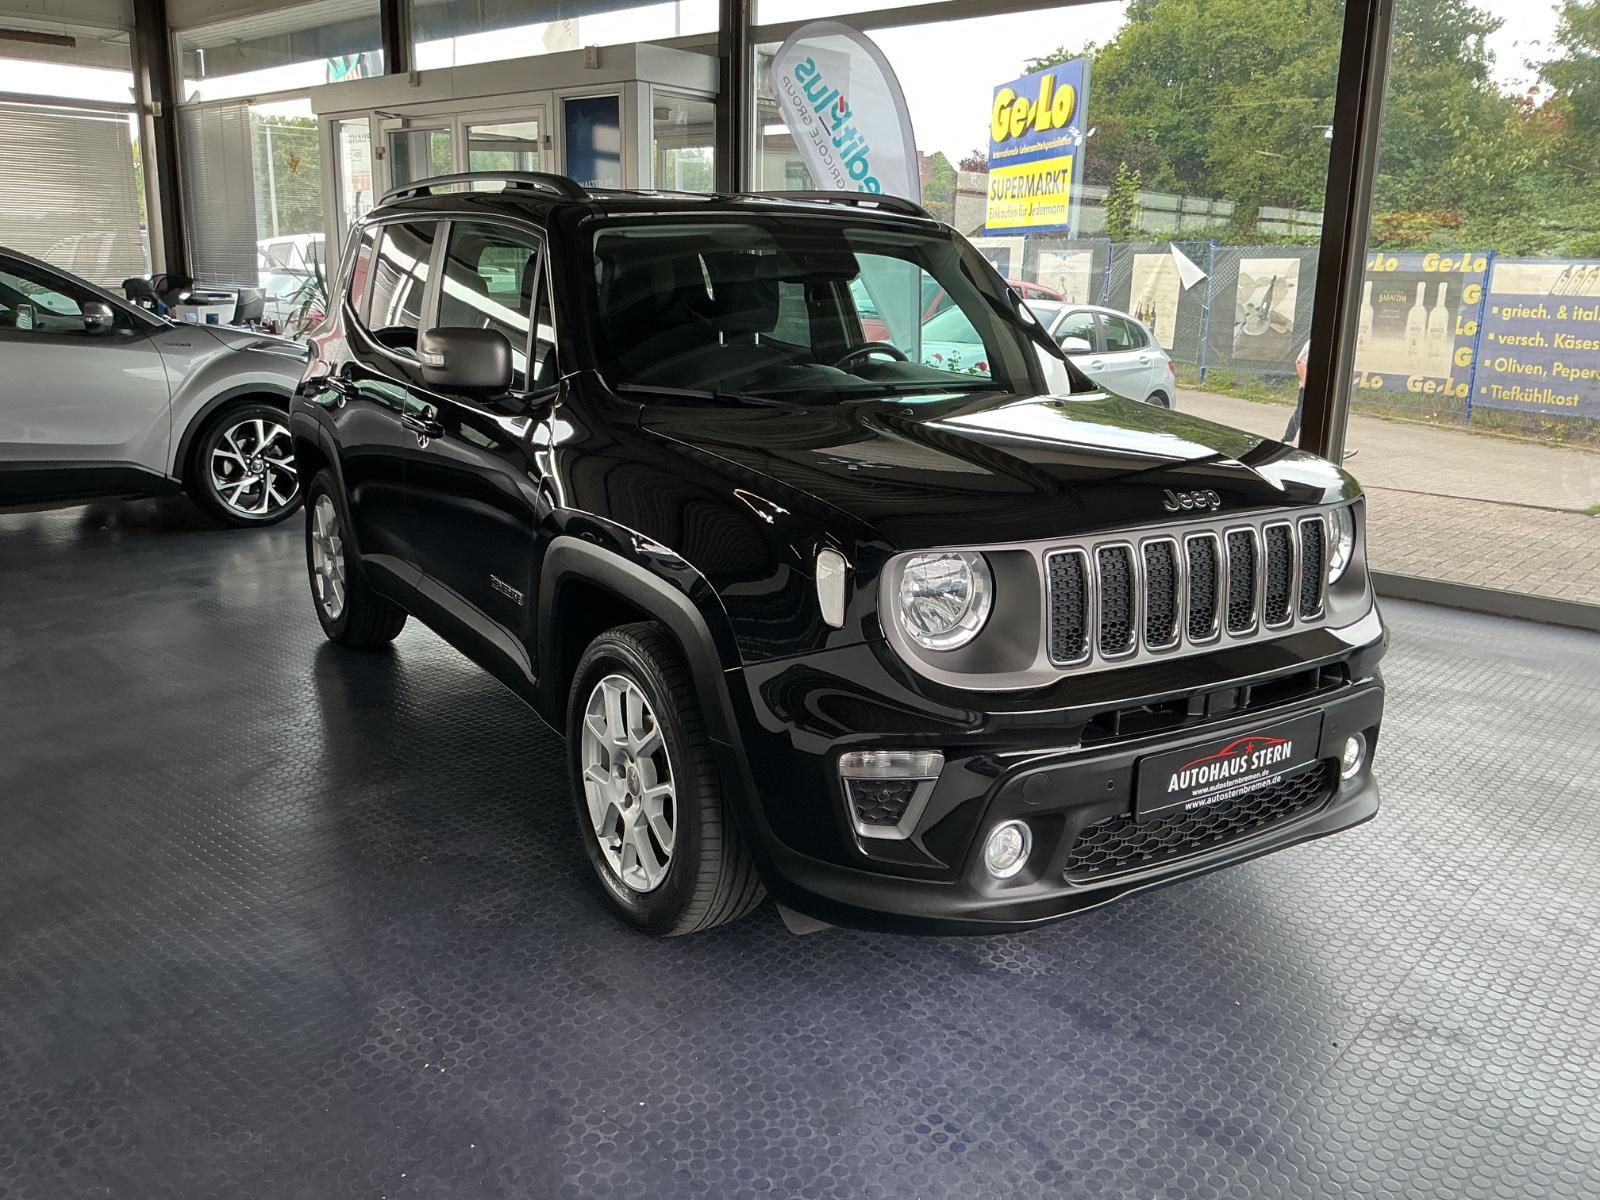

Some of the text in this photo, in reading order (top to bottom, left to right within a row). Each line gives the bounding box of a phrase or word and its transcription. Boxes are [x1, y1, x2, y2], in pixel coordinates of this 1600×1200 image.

[991, 169, 1067, 201] SUPERMARKT
[989, 205, 1017, 219] Einkaufen
[1028, 202, 1065, 216] Jedermann
[1502, 304, 1551, 321] griech.
[1557, 305, 1568, 320] &
[1499, 331, 1548, 347] versch.
[1494, 357, 1548, 377] Oliven,
[1491, 384, 1580, 407] Tiefkühlkost
[1161, 489, 1221, 512] Jeep
[1167, 741, 1292, 793] AUTOHAUS STERN
[1185, 775, 1281, 810] www.autosternbremen.de
[1192, 769, 1269, 796] www.autosternbremen.de
